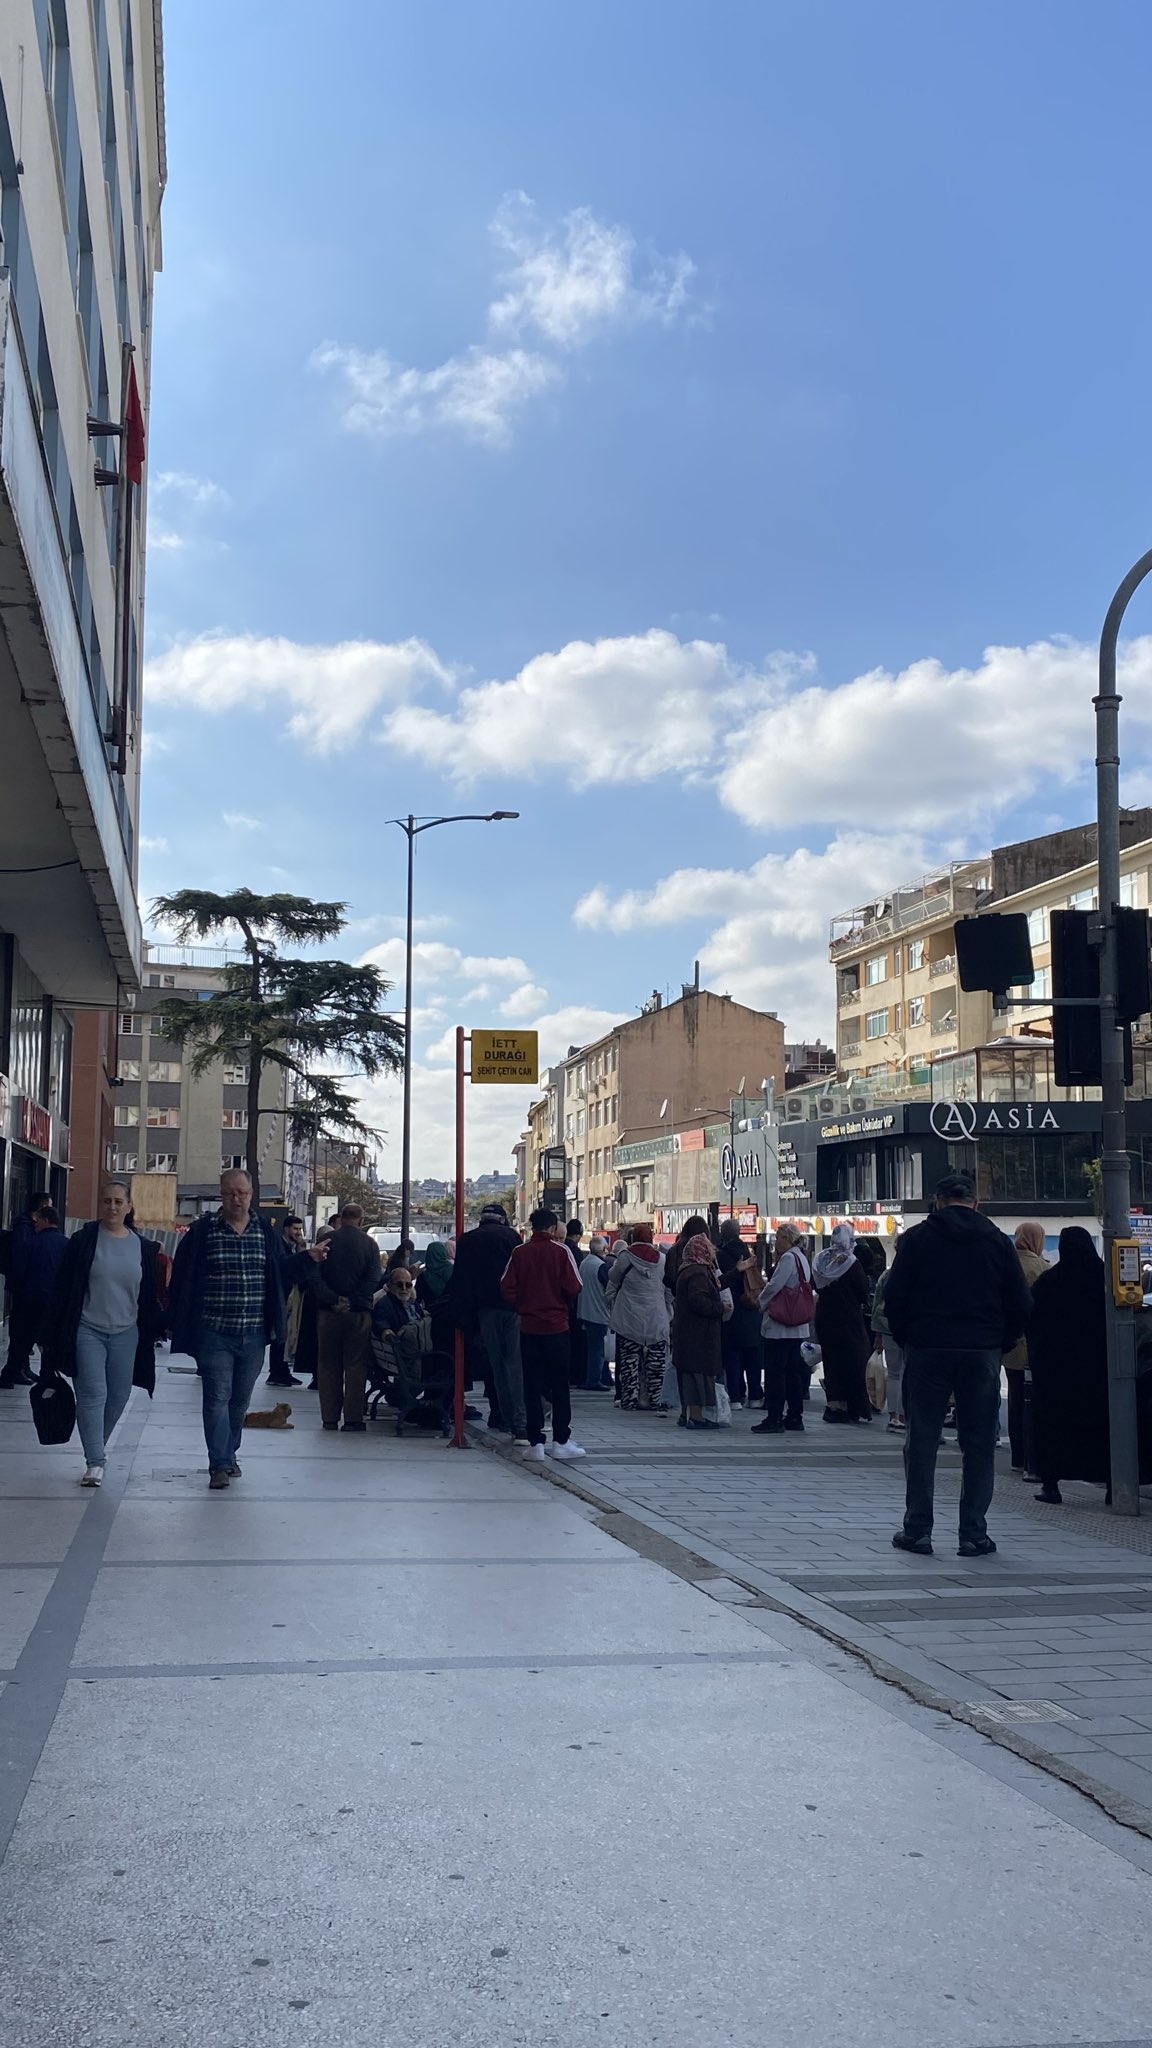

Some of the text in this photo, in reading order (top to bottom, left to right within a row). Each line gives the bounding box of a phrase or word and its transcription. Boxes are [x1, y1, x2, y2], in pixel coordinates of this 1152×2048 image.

[492, 1037, 518, 1049] İETT
[484, 1049, 526, 1061] DURAĞI
[477, 1066, 497, 1077] ŞEHİT
[518, 1066, 532, 1076] CAN
[983, 1103, 1060, 1130] ASİA
[861, 1117, 883, 1131] Üsküdar
[736, 1150, 761, 1177] ASİA
